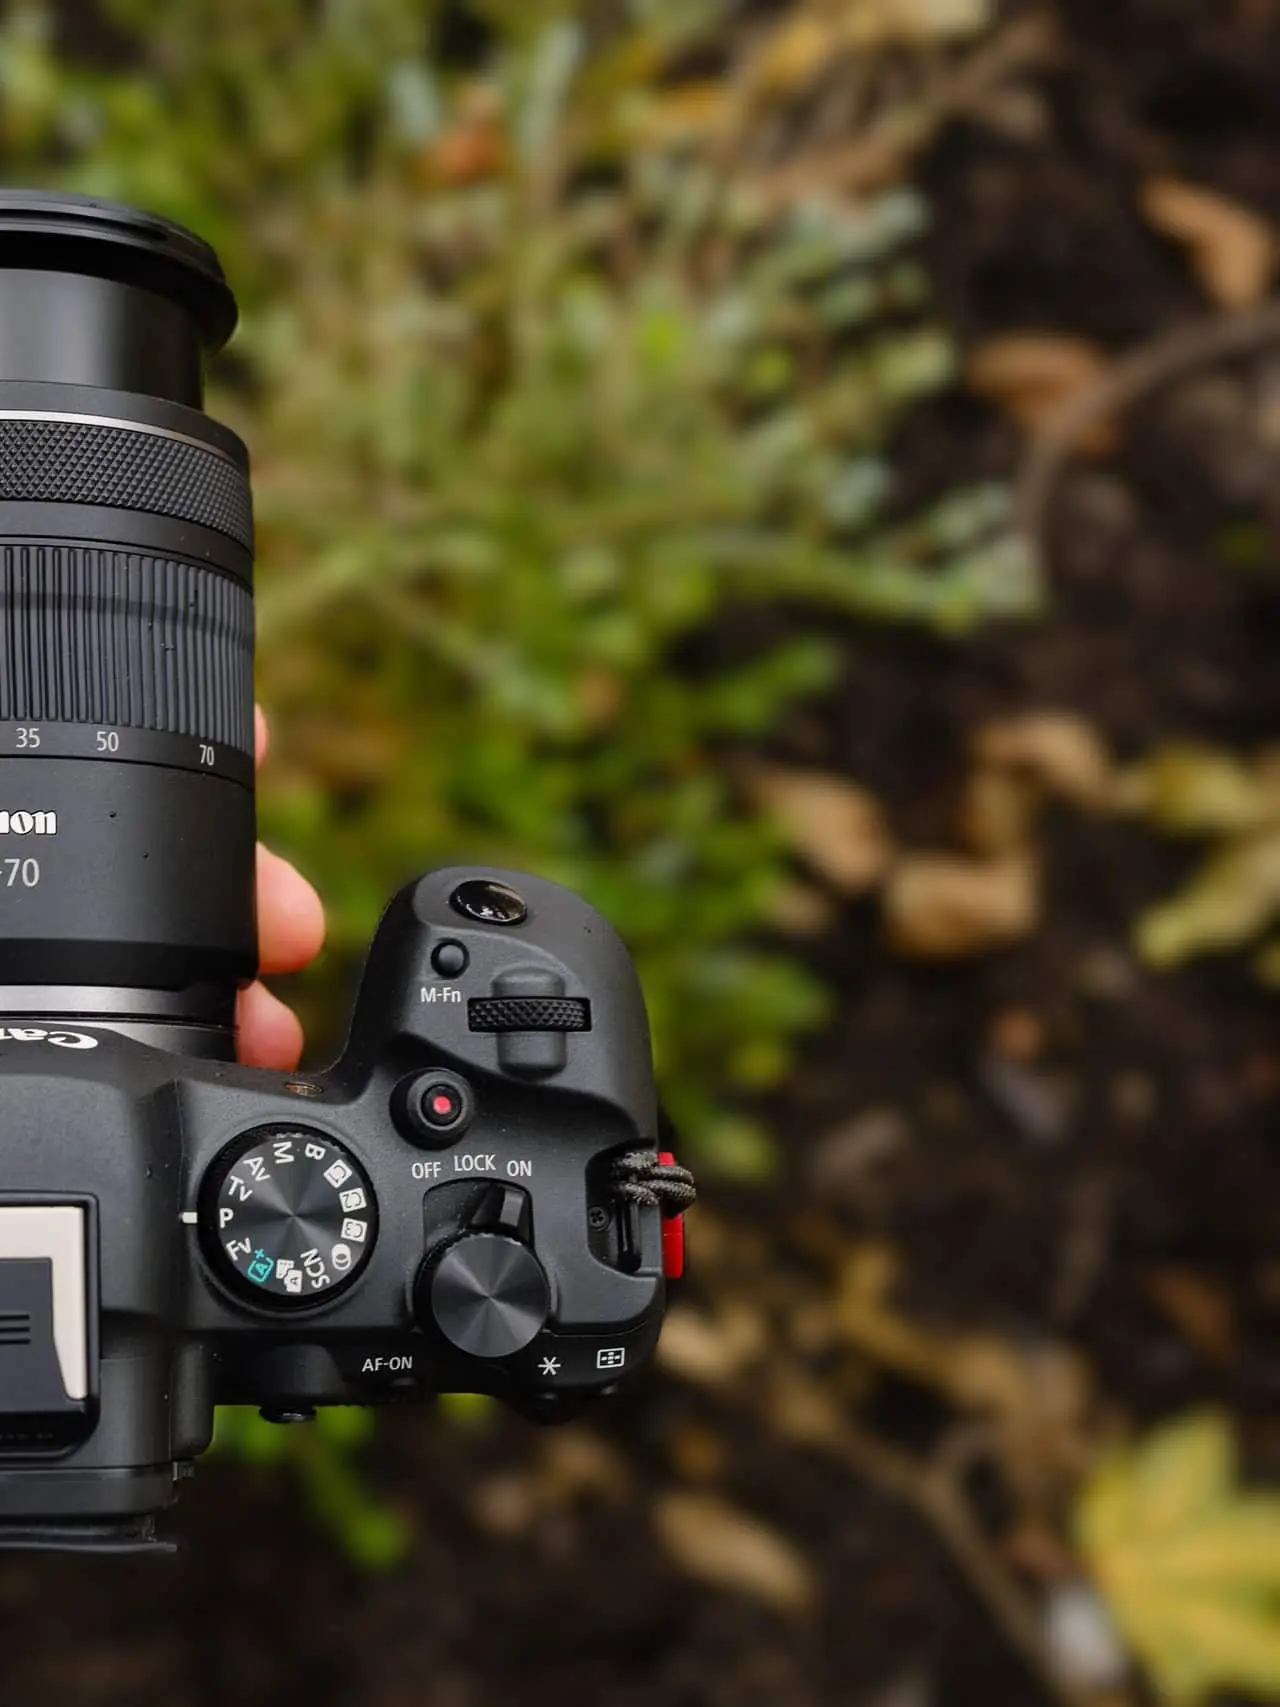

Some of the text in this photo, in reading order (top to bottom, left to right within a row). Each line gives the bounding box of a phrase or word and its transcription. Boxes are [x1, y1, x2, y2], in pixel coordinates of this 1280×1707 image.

[15, 728, 41, 748] 35
[96, 731, 120, 752] 50
[199, 744, 215, 766] 70
[420, 987, 462, 1003] M-Fn
[272, 1141, 295, 1164] M
[304, 1143, 326, 1160] B
[242, 1156, 271, 1182] Av
[325, 1162, 349, 1185] C1
[411, 1154, 533, 1179] OFF LOCK ON
[228, 1175, 254, 1202] Tv
[341, 1189, 364, 1210] C2
[219, 1207, 235, 1229] P
[343, 1219, 365, 1240] C3
[225, 1237, 252, 1261] Fv
[300, 1248, 331, 1289] SCN
[361, 1356, 413, 1372] AF-ON
